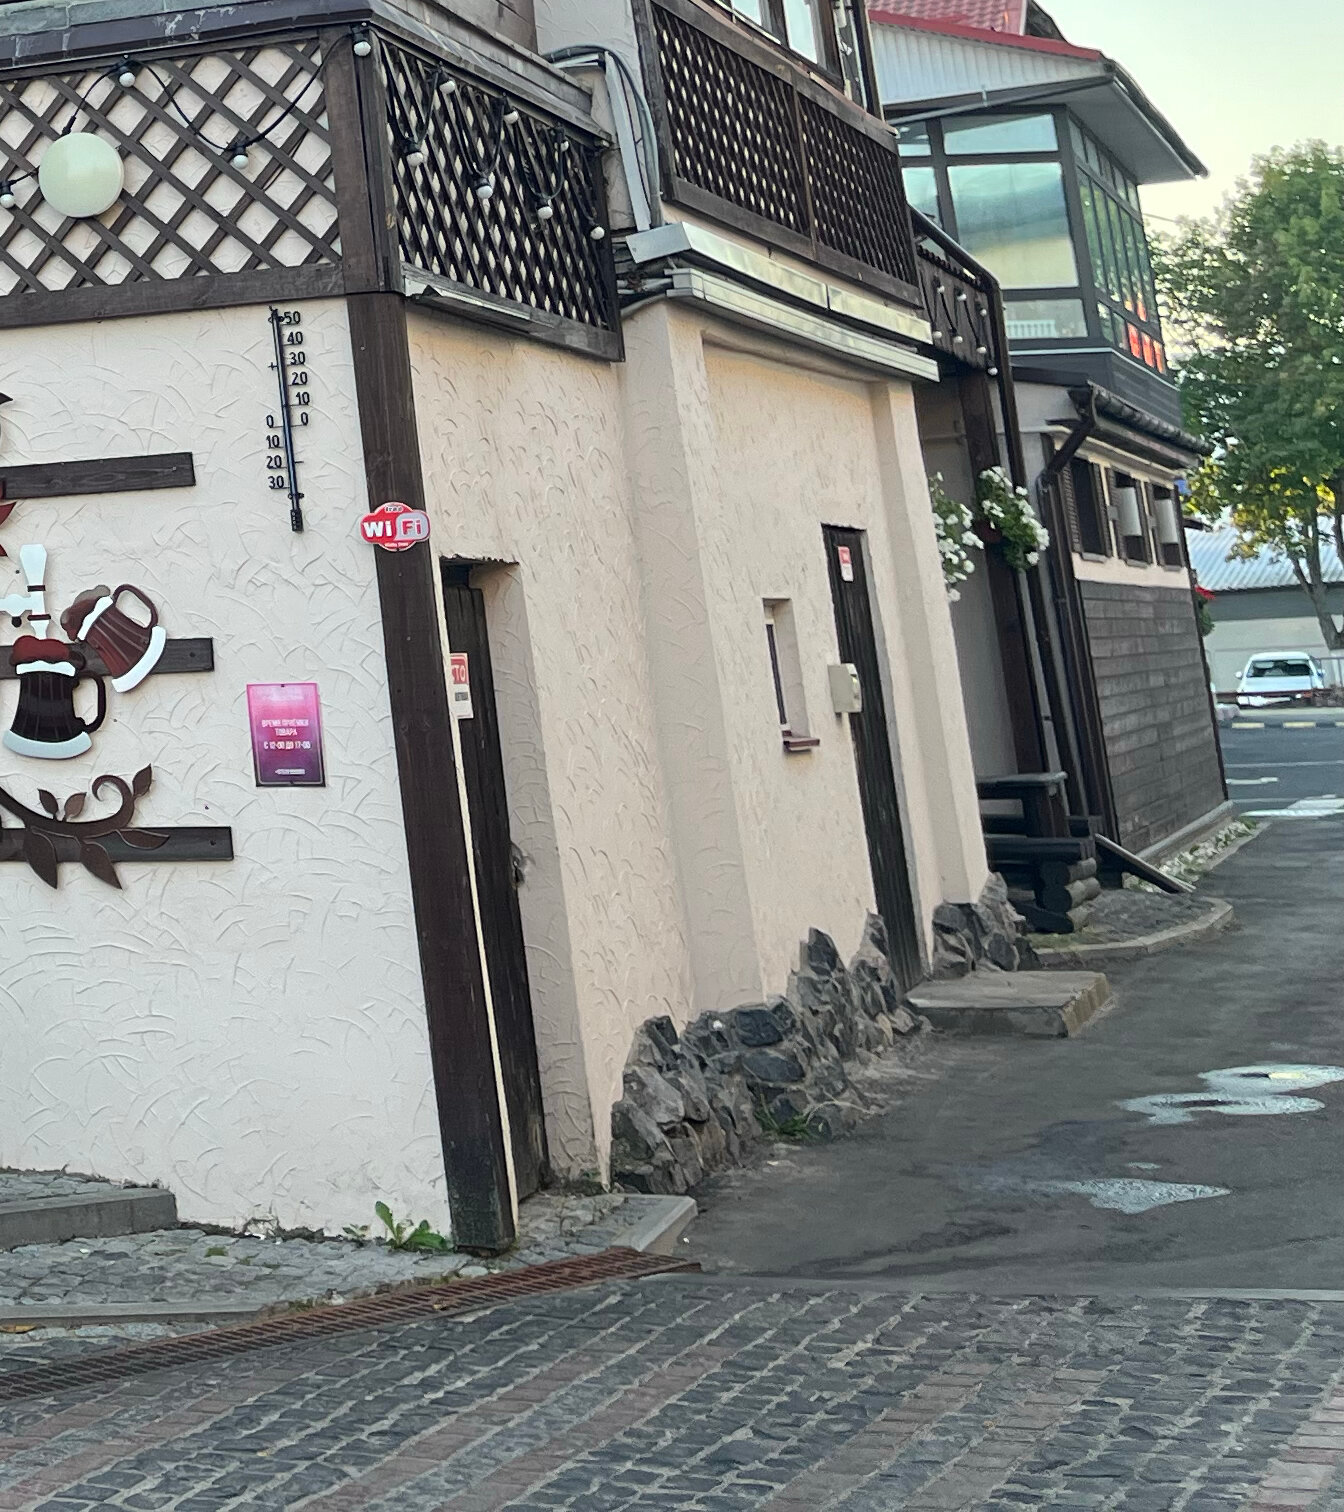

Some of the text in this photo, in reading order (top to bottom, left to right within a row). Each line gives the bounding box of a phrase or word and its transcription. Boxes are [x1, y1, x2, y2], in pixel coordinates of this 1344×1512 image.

[284, 310, 301, 325] 50
[287, 331, 304, 345] 40
[289, 351, 306, 365] 30
[292, 371, 308, 385] 20
[295, 391, 310, 406] 10
[266, 414, 274, 428] 0
[300, 411, 309, 426] 0
[266, 434, 280, 449] 10
[266, 455, 282, 469] 20
[267, 475, 285, 489] 30
[363, 519, 422, 538] Wi Fi
